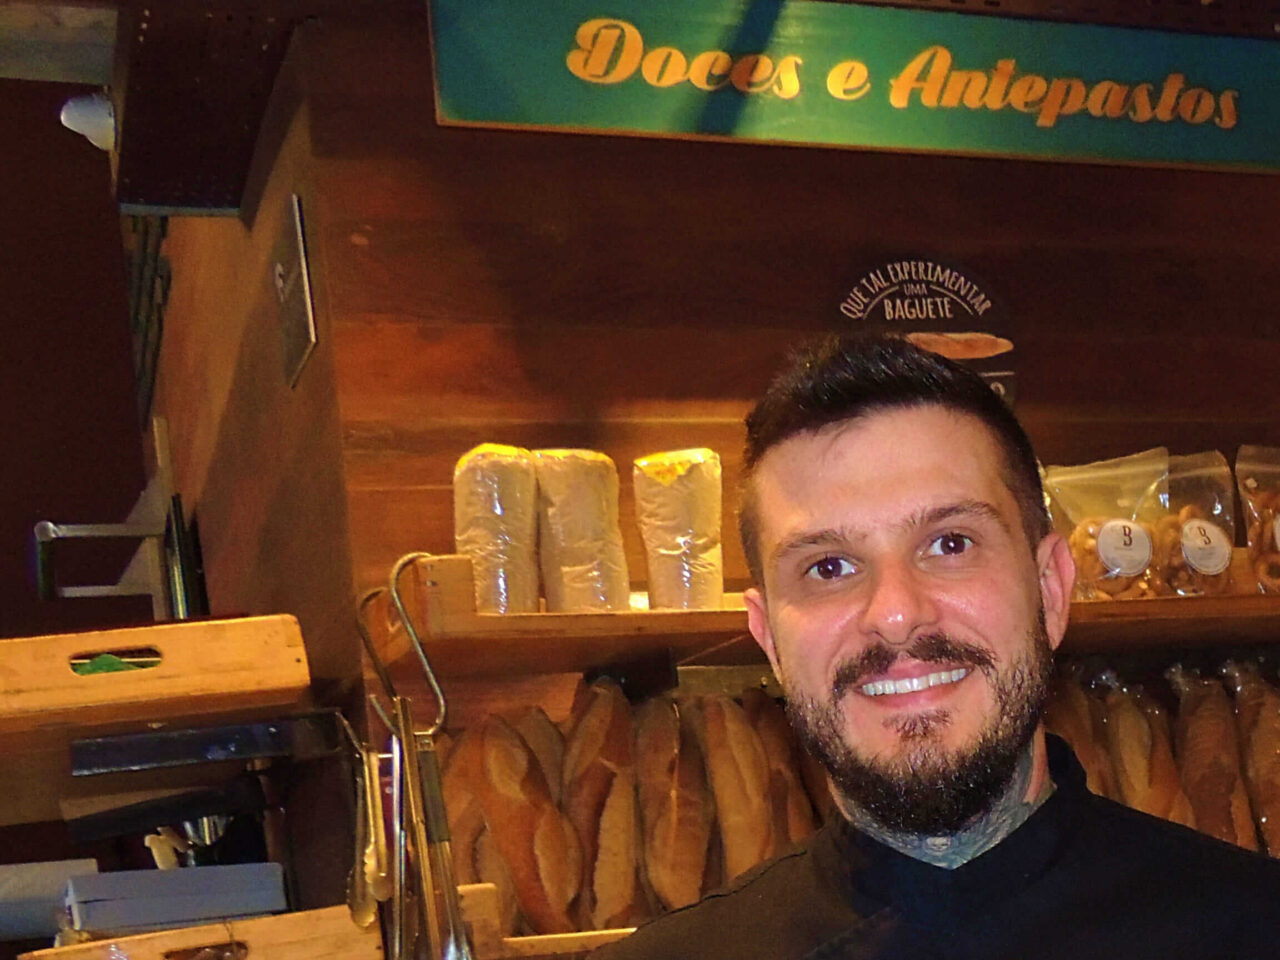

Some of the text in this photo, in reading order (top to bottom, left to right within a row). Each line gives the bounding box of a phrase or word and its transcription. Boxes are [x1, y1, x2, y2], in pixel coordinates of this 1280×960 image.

[566, 17, 1240, 130] Doces e Antepastos
[839, 260, 992, 319] QUE TAL EXPERIMENTAR
[883, 296, 954, 321] BAGUETE
[903, 282, 928, 296] UMA
